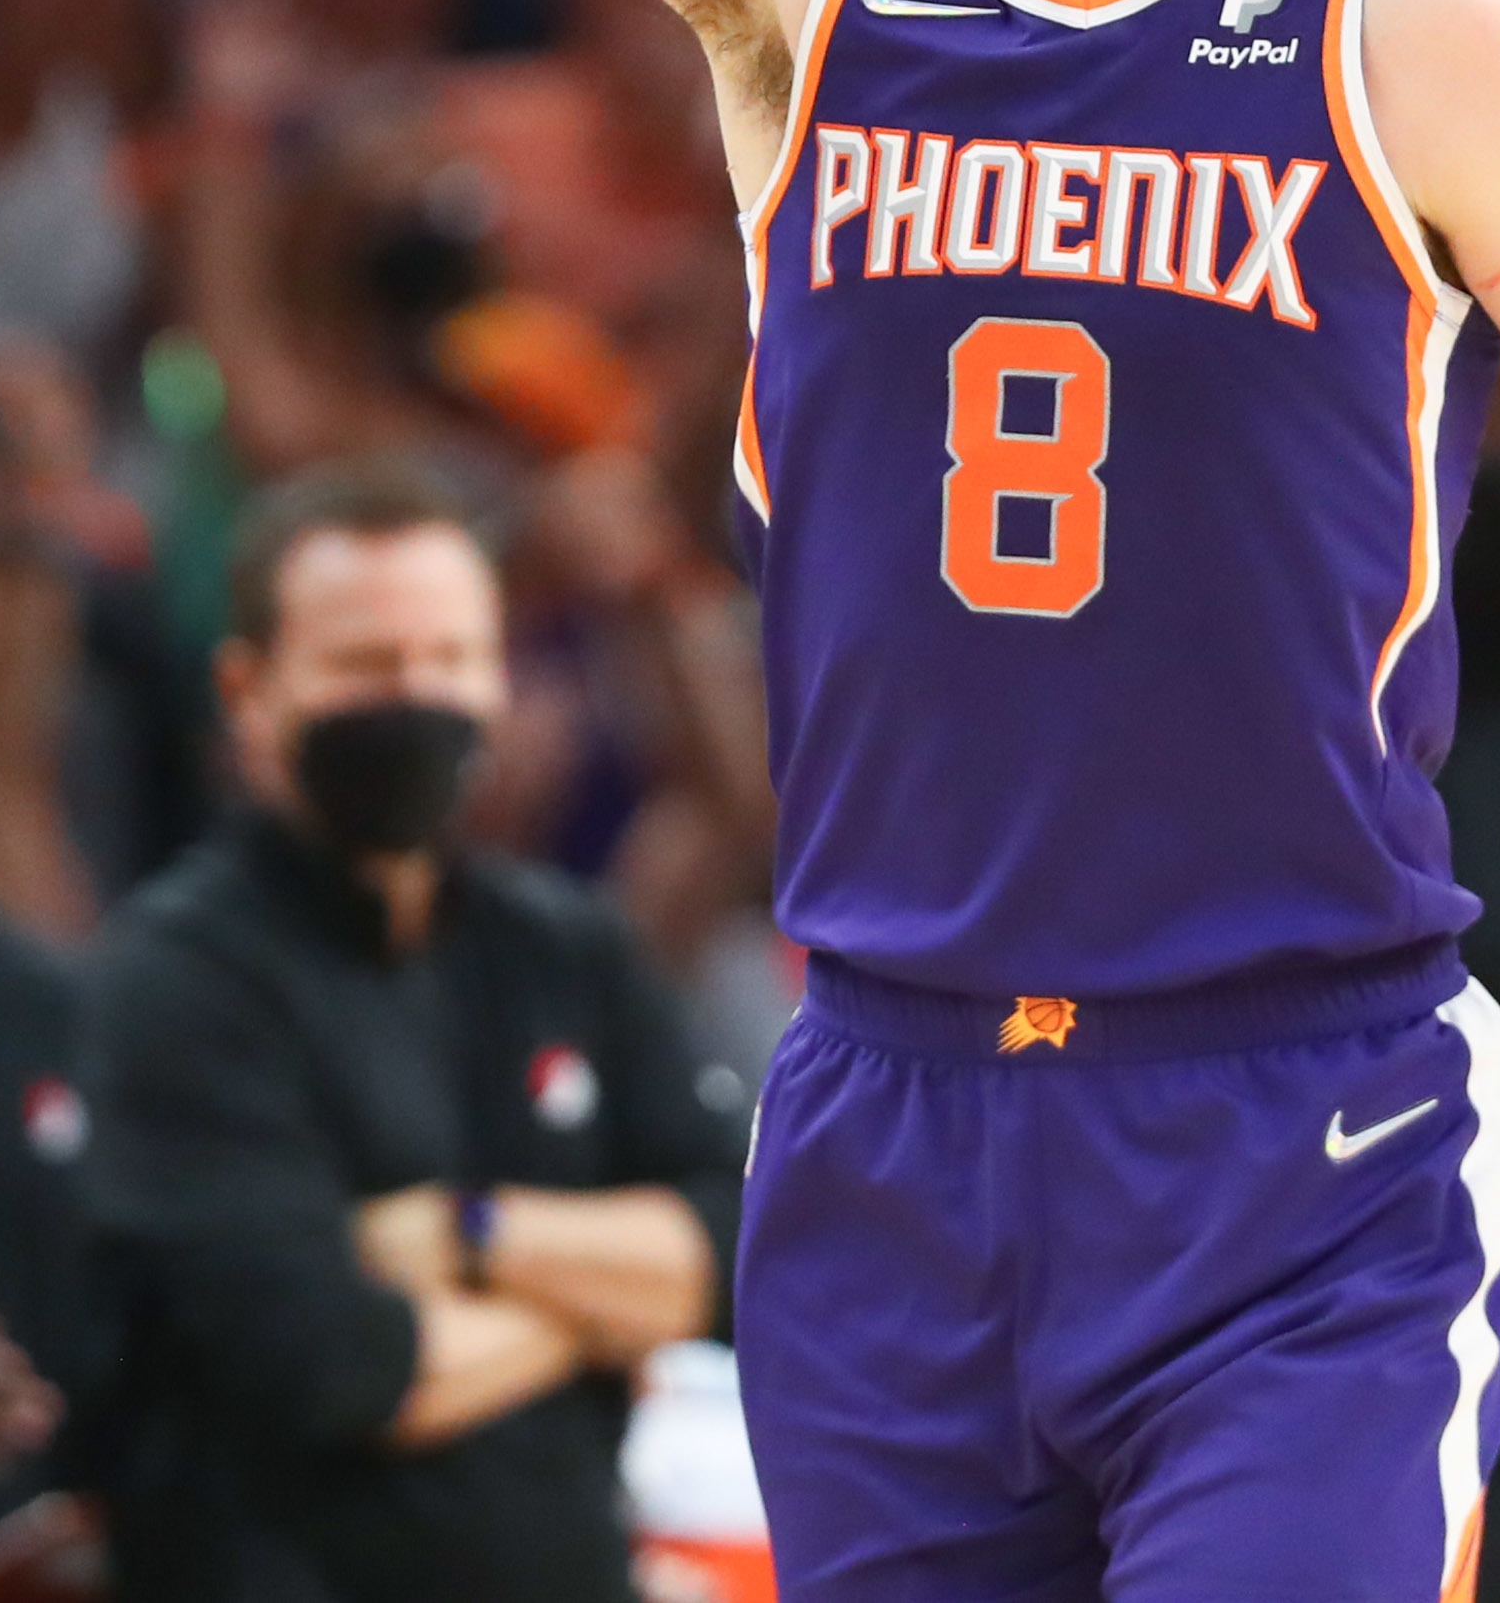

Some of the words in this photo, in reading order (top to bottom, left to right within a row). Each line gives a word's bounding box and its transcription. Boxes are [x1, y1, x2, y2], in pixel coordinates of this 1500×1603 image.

[1187, 37, 1299, 69] PayPal
[810, 122, 1328, 331] PHOENIX
[940, 316, 1111, 619] 8
